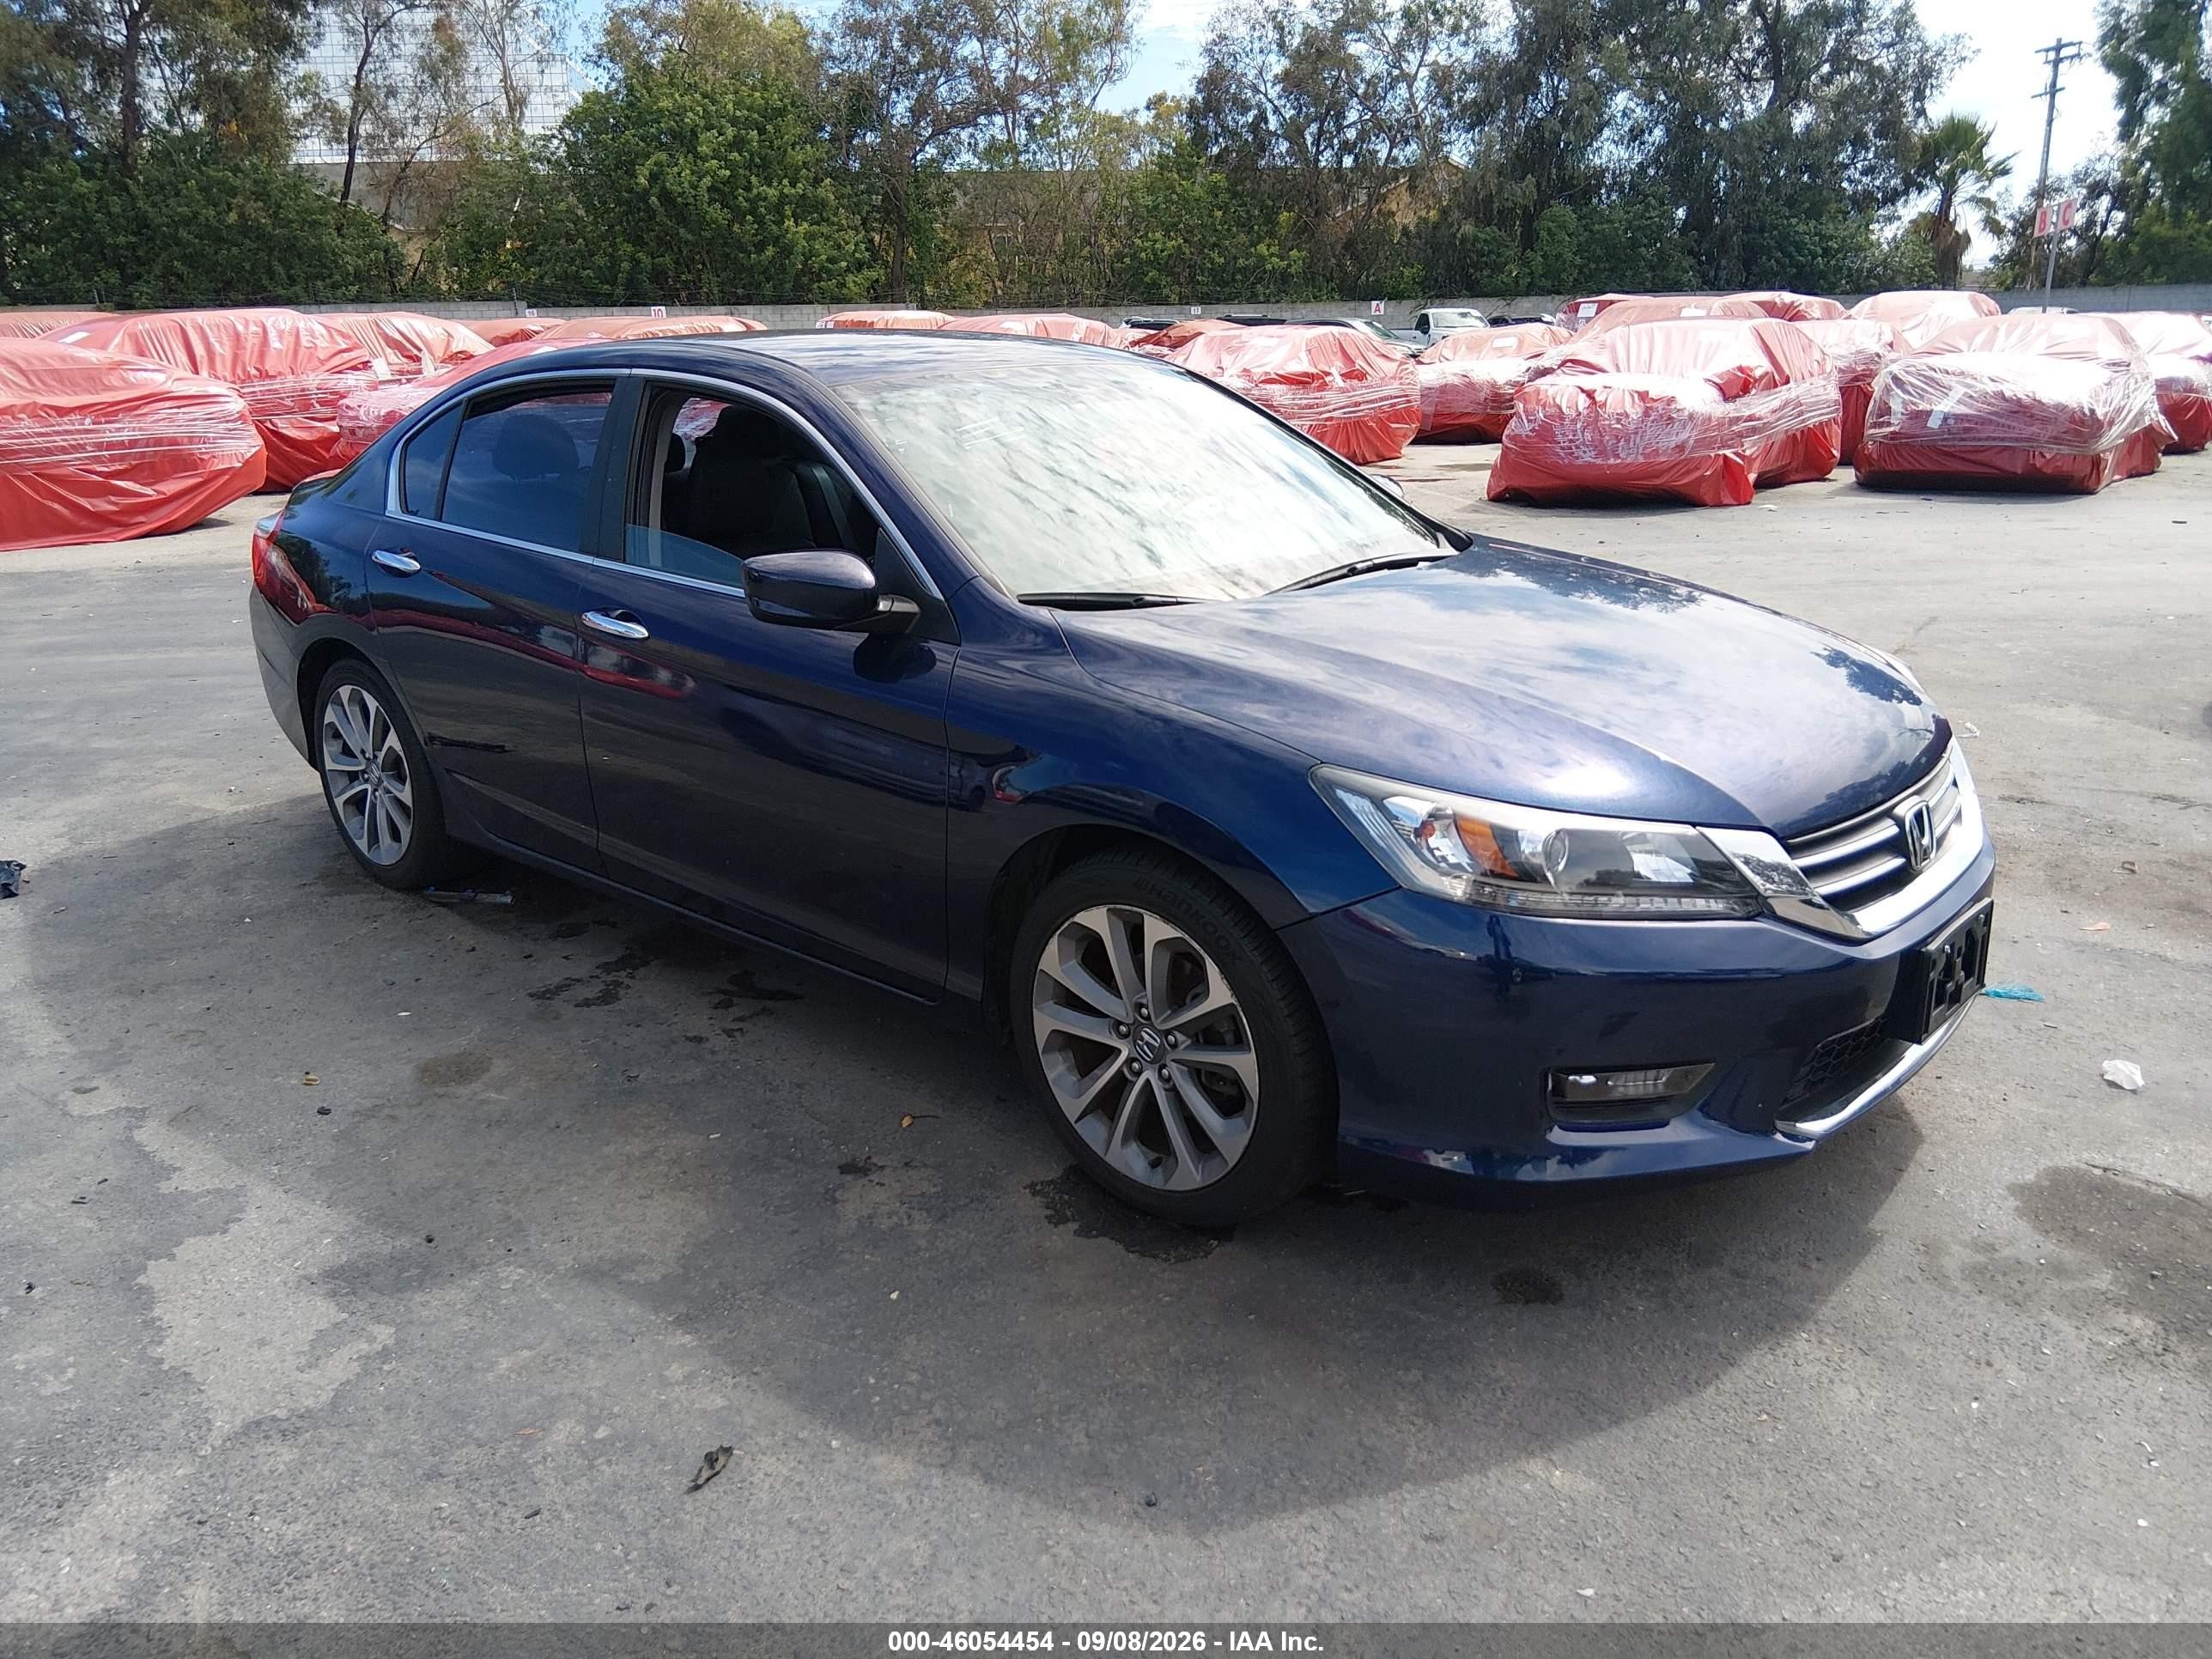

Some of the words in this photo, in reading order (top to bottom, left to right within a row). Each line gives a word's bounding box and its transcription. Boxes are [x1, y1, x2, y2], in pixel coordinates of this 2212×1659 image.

[2038, 210, 2047, 234] B
[2063, 202, 2072, 226] C
[653, 308, 664, 318] 10
[1374, 302, 1381, 313] A
